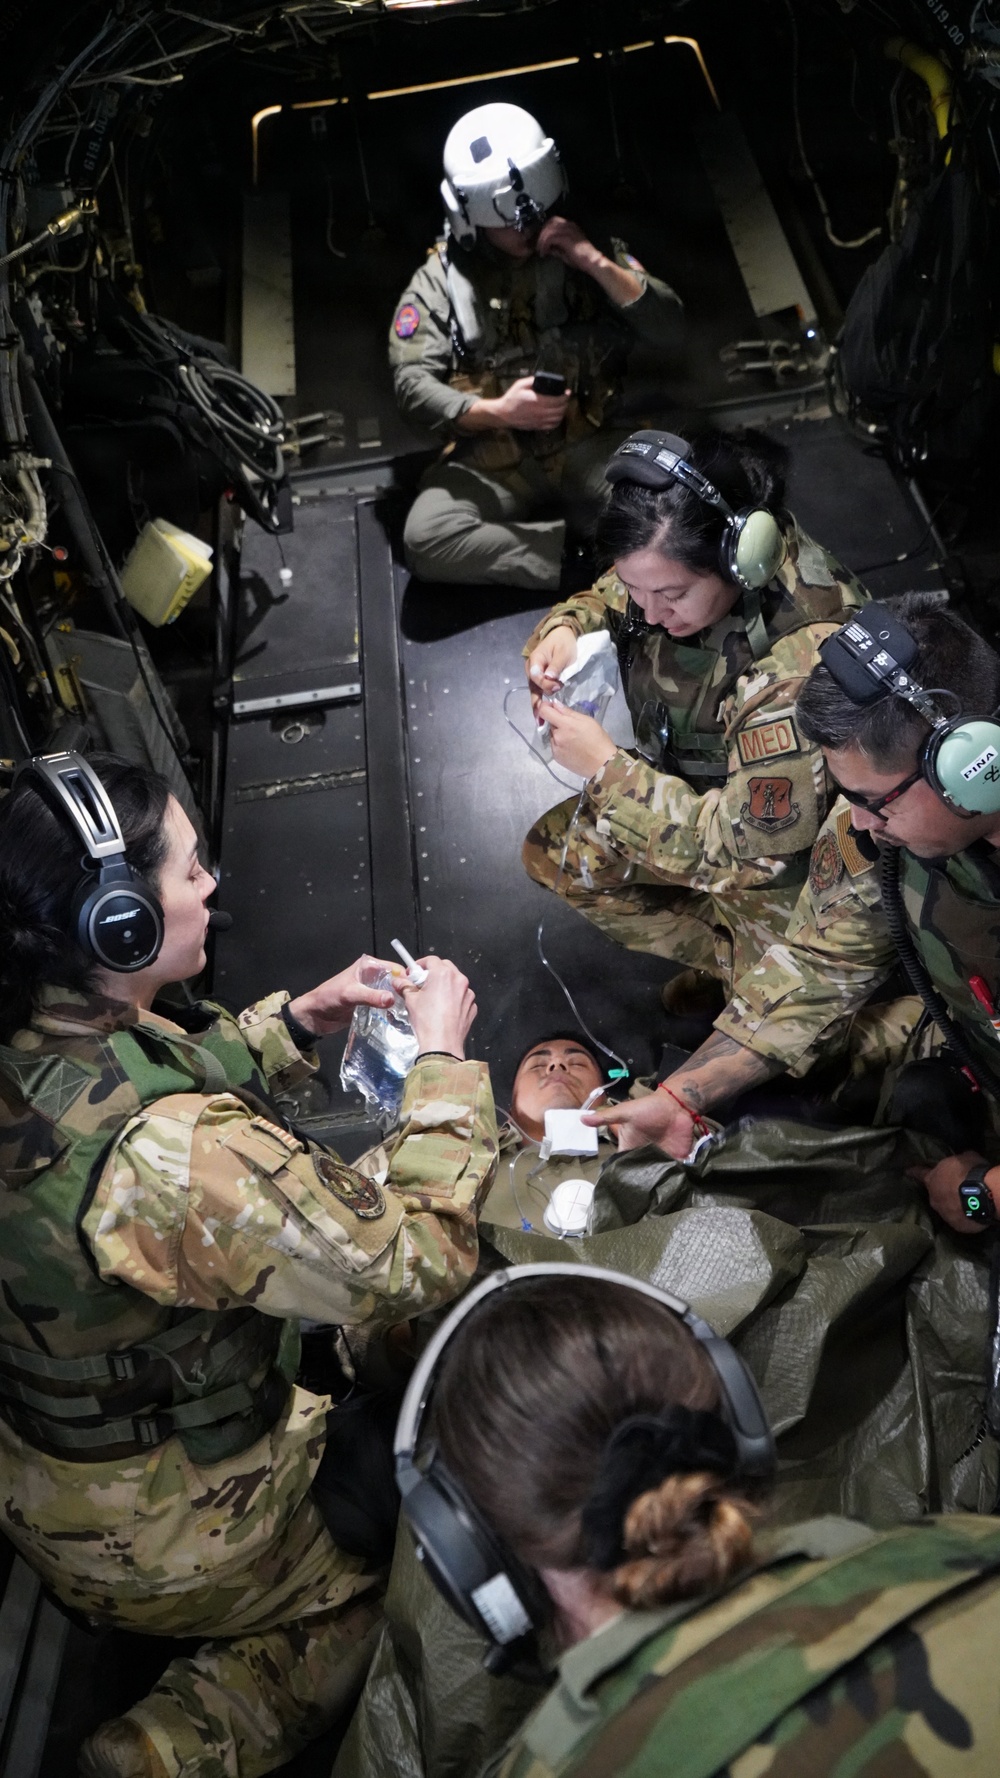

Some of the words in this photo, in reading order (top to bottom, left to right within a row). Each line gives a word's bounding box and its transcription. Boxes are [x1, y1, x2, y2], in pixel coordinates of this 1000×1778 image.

[741, 723, 791, 760] MED
[963, 752, 995, 779] PINA
[101, 909, 139, 923] BOSE
